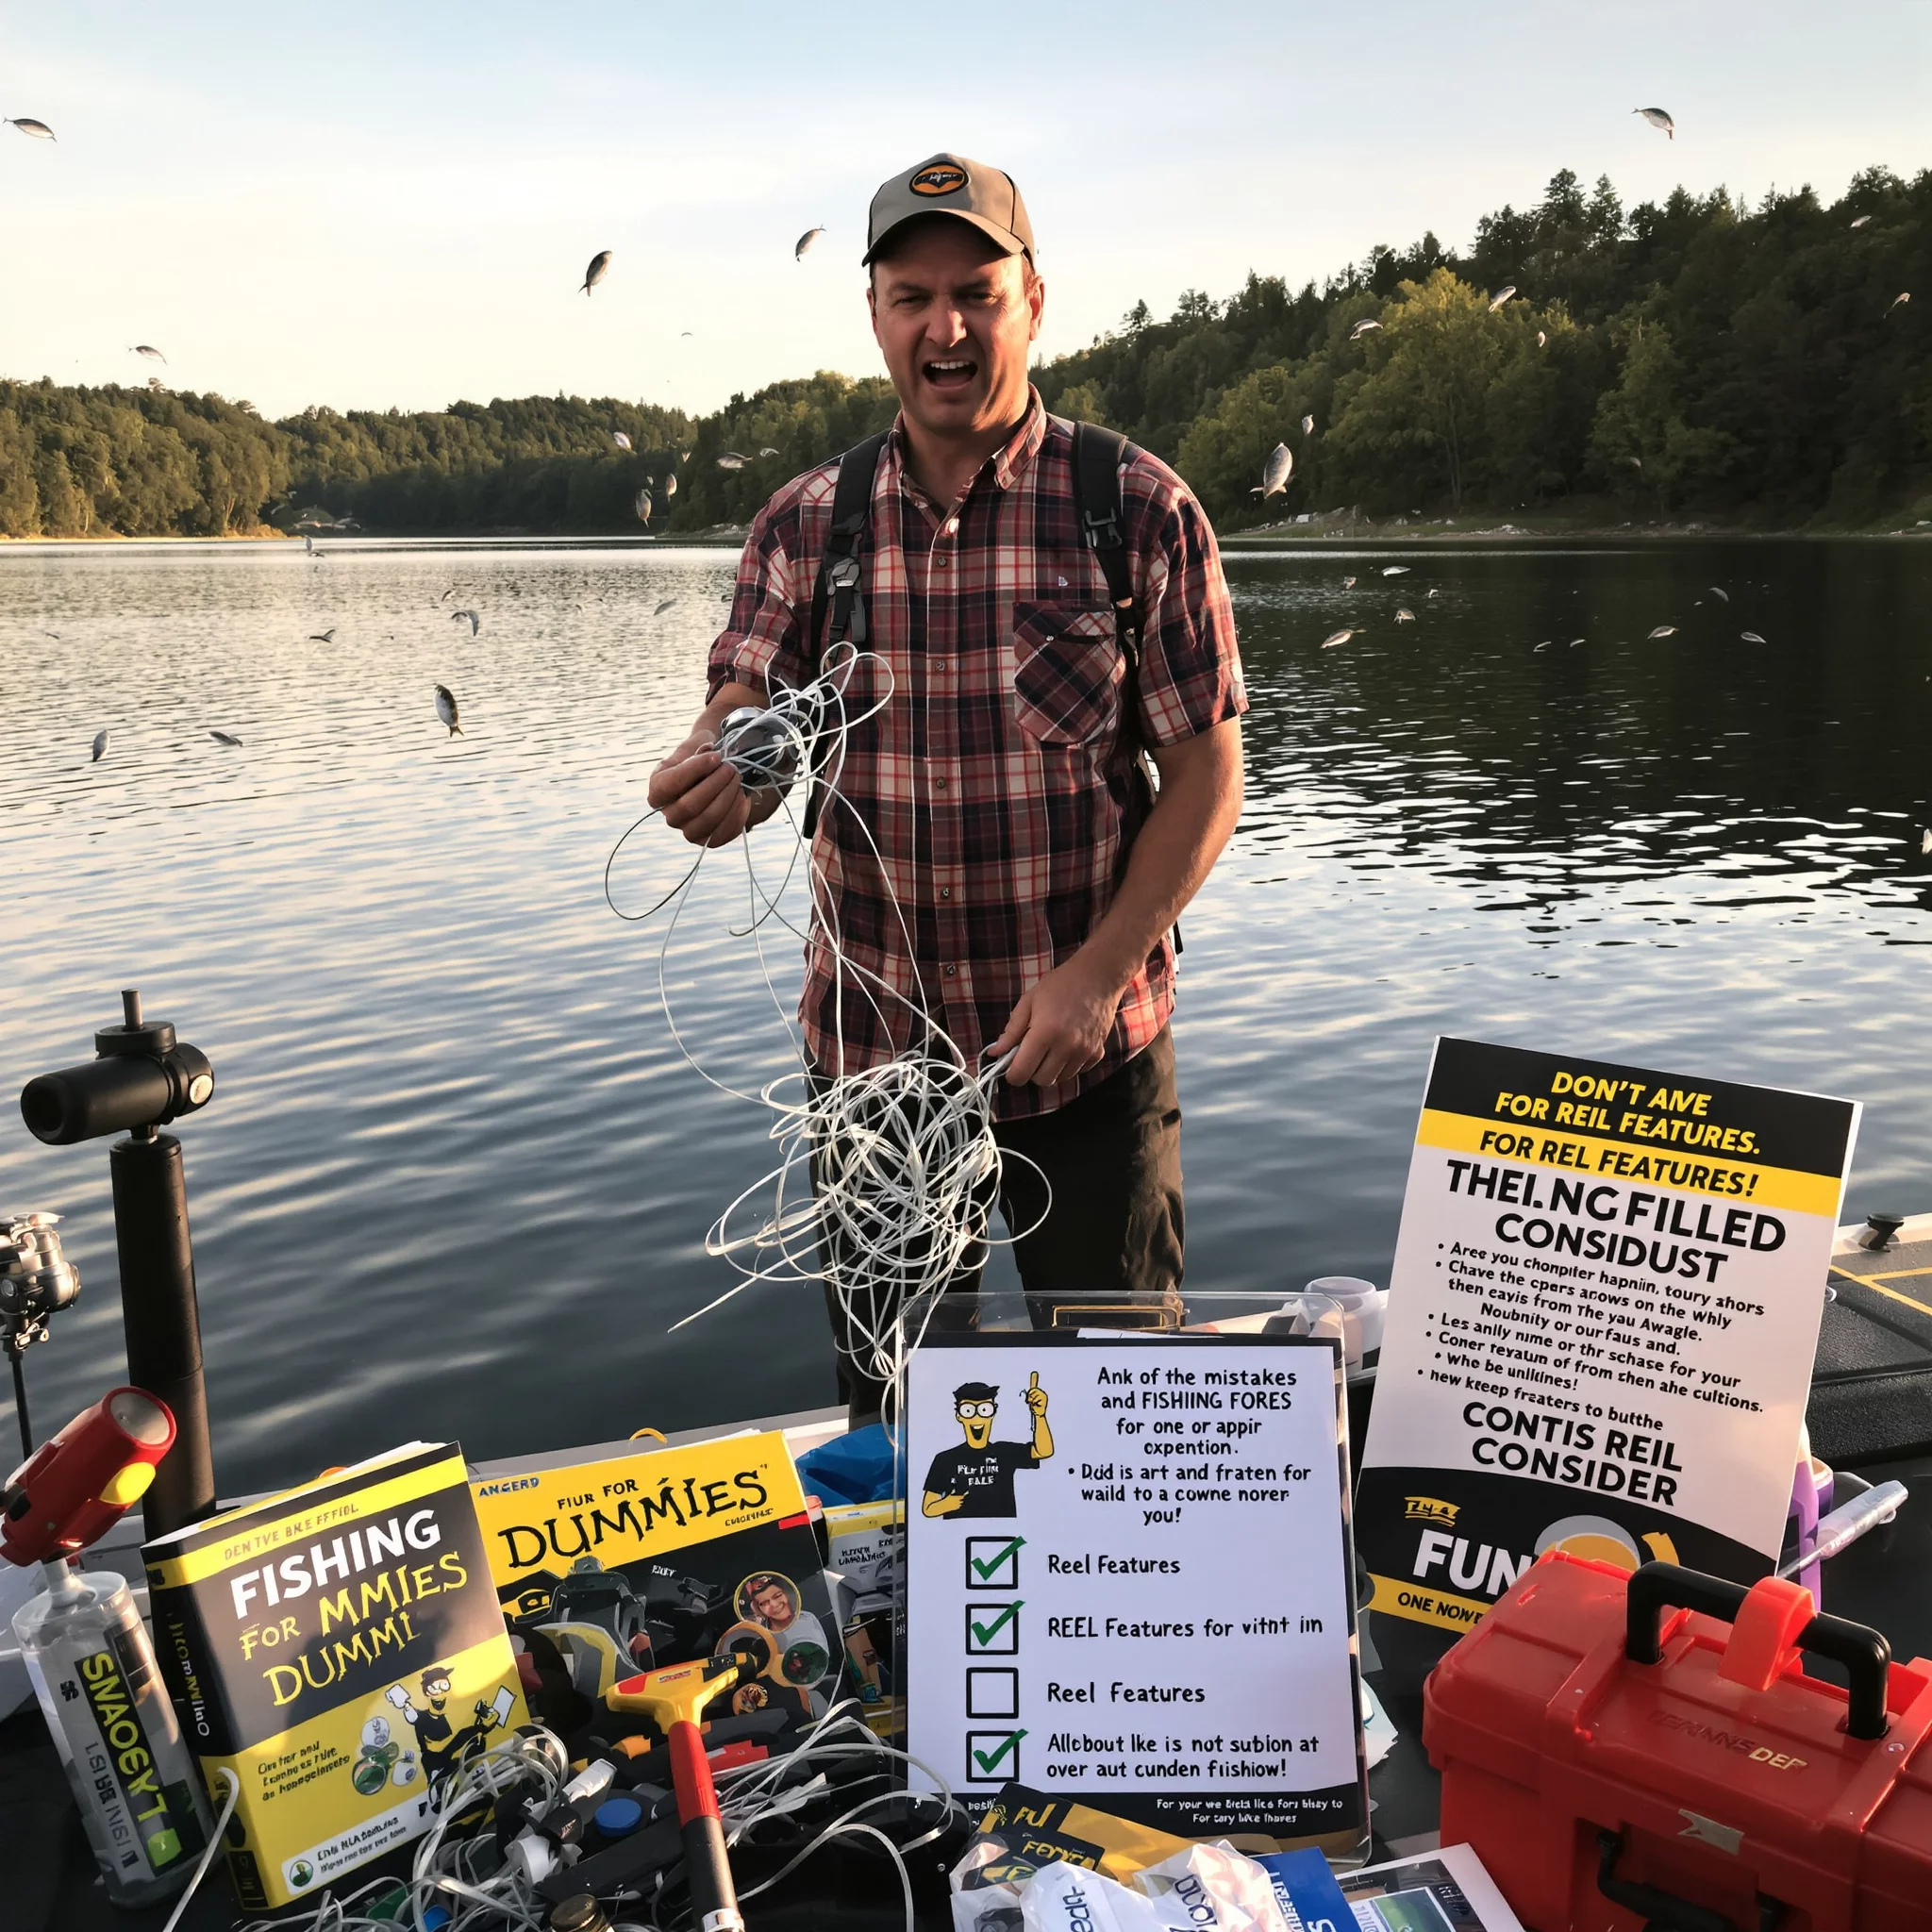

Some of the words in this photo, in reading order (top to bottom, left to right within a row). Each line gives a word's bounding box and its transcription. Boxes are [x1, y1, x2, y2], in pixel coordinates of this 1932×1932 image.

[1551, 1072, 1646, 1105] DON'T
[1494, 1091, 1550, 1120] FOR
[1619, 1112, 1759, 1155] FEATURES.
[1480, 1131, 1534, 1158] FOR
[1540, 1140, 1590, 1169] REL
[1598, 1150, 1758, 1196] FEATURES!
[1625, 1191, 1786, 1252] FILLED
[1495, 1213, 1728, 1283] CONSIDUST
[1449, 1260, 1494, 1279] Chave
[1500, 1271, 1524, 1286] the
[1635, 1300, 1654, 1311] on
[1660, 1303, 1686, 1319] the
[1491, 1253, 1519, 1266] you
[1665, 1286, 1711, 1307] toury
[1449, 1278, 1483, 1295] then
[1533, 1293, 1572, 1315] from
[1577, 1305, 1604, 1320] The
[1640, 1318, 1702, 1341] Awagle.
[1441, 1312, 1469, 1330] Les
[1557, 1341, 1575, 1352] or
[1580, 1343, 1605, 1357] thr
[1608, 1352, 1664, 1372] schase
[1670, 1360, 1696, 1377] for
[1701, 1371, 1740, 1388] your
[1555, 1321, 1572, 1332] or
[1575, 1325, 1604, 1338] our
[1606, 1328, 1641, 1347] faus
[1646, 1341, 1680, 1356] and.
[1097, 1367, 1133, 1385] Ank
[1140, 1368, 1160, 1385] of
[1165, 1367, 1195, 1386] the
[1205, 1368, 1297, 1386] mistakes
[1485, 1359, 1503, 1374] be
[1101, 1391, 1135, 1409] and
[1230, 1391, 1291, 1410] FORES
[1430, 1370, 1461, 1386] new
[1585, 1404, 1603, 1417] to
[1554, 1357, 1571, 1369] of
[1574, 1360, 1612, 1380] from
[1693, 1390, 1762, 1412] cultions.
[1116, 1418, 1145, 1435] for
[1154, 1422, 1184, 1435] one
[1191, 1422, 1211, 1434] or
[1216, 1418, 1262, 1439] appir
[1463, 1402, 1596, 1450] CONTIS
[1605, 1429, 1682, 1473] REIL
[603, 1479, 640, 1497] FOR
[1120, 1465, 1133, 1480] is
[1141, 1465, 1169, 1480] art
[1175, 1463, 1208, 1480] and
[1216, 1463, 1276, 1482] fraten
[1283, 1464, 1311, 1481] for
[1473, 1438, 1677, 1507] CONSIDER
[1081, 1484, 1125, 1502] waild
[1133, 1487, 1153, 1501] to
[1159, 1489, 1169, 1502] a
[1175, 1489, 1232, 1502] cowne
[1142, 1507, 1181, 1526] you!
[230, 1509, 441, 1620] FISHING
[1048, 1554, 1091, 1574] Reel
[1098, 1555, 1180, 1574] Features
[239, 1616, 301, 1661] FOR
[319, 1551, 469, 1638] MMIES
[1398, 1592, 1434, 1612] ONE
[1048, 1616, 1098, 1638] REEL
[1106, 1618, 1194, 1638] Features
[1204, 1619, 1234, 1637] for
[1048, 1681, 1094, 1703] Reel
[1110, 1682, 1205, 1703] Features
[1165, 1736, 1182, 1753] is
[1191, 1735, 1224, 1753] not
[1299, 1736, 1319, 1753] at
[1047, 1764, 1089, 1777] over
[1096, 1761, 1127, 1777] aut
[1135, 1758, 1200, 1777] cunden
[1178, 1800, 1203, 1811] your
